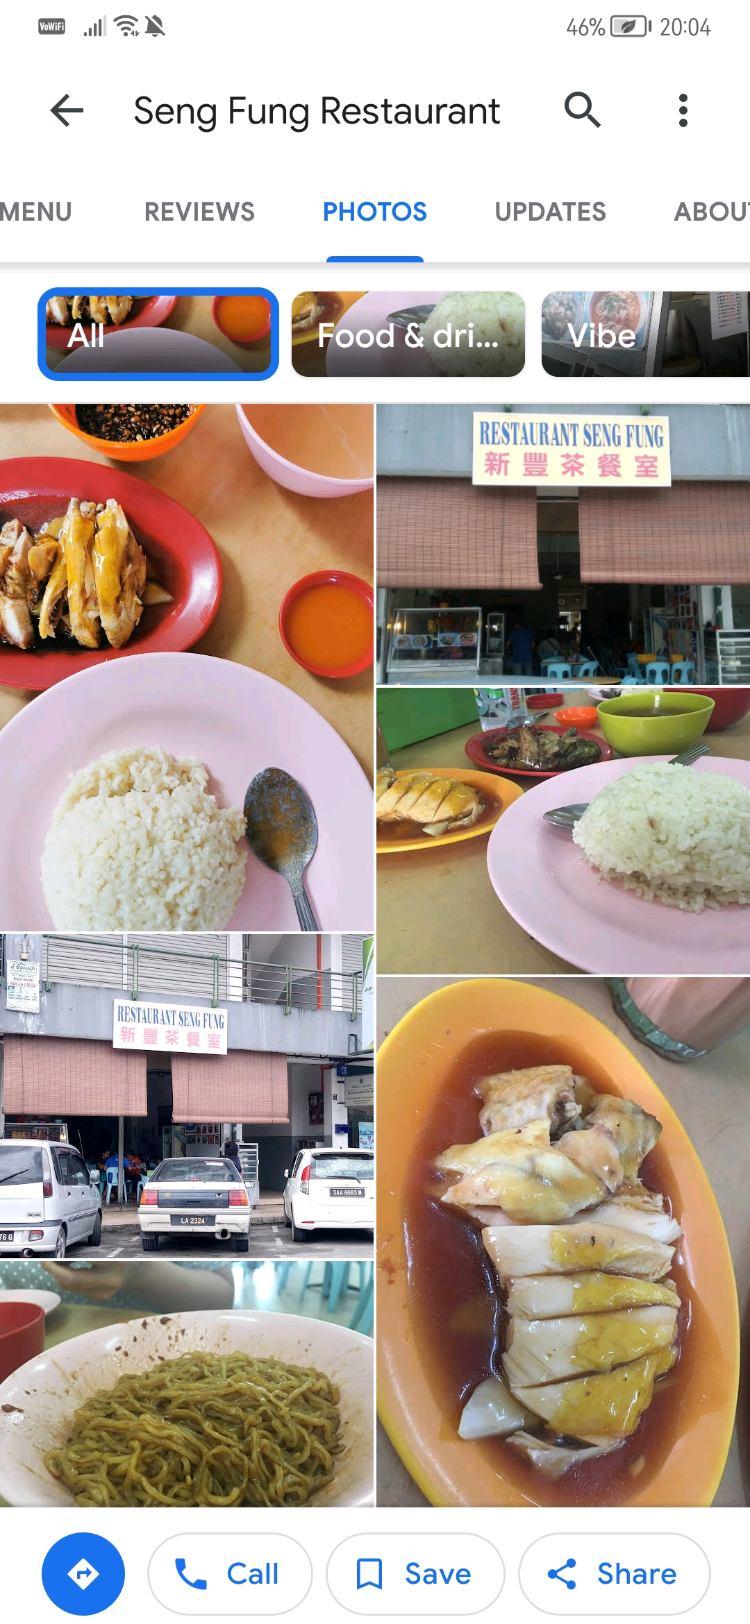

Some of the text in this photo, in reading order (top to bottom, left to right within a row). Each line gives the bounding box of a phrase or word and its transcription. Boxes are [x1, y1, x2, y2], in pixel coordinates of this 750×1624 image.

[39, 21, 65, 31] VoWiFi
[566, 17, 606, 36] 46%
[660, 17, 712, 36] 20:04
[134, 95, 501, 133] Seng Fung Restaurant
[0, 201, 72, 222] MENU
[145, 201, 255, 222] REVIEWS
[323, 200, 428, 222] PHOTOS
[495, 201, 607, 222] UPDATES
[673, 200, 750, 222] ABOU
[67, 322, 105, 348] All
[318, 322, 395, 349] Food
[404, 322, 424, 349] &
[567, 322, 636, 349] Vibe
[479, 421, 664, 448] RESTAURANT SENG FUNG
[484, 451, 659, 478] 新豐茶餐室
[117, 1005, 225, 1030] RESTAURANT SENG FUNG
[120, 1026, 222, 1049] 新豐茶餐室
[227, 1561, 278, 1585] Call
[405, 1561, 472, 1585] Save
[597, 1561, 677, 1585] Share
